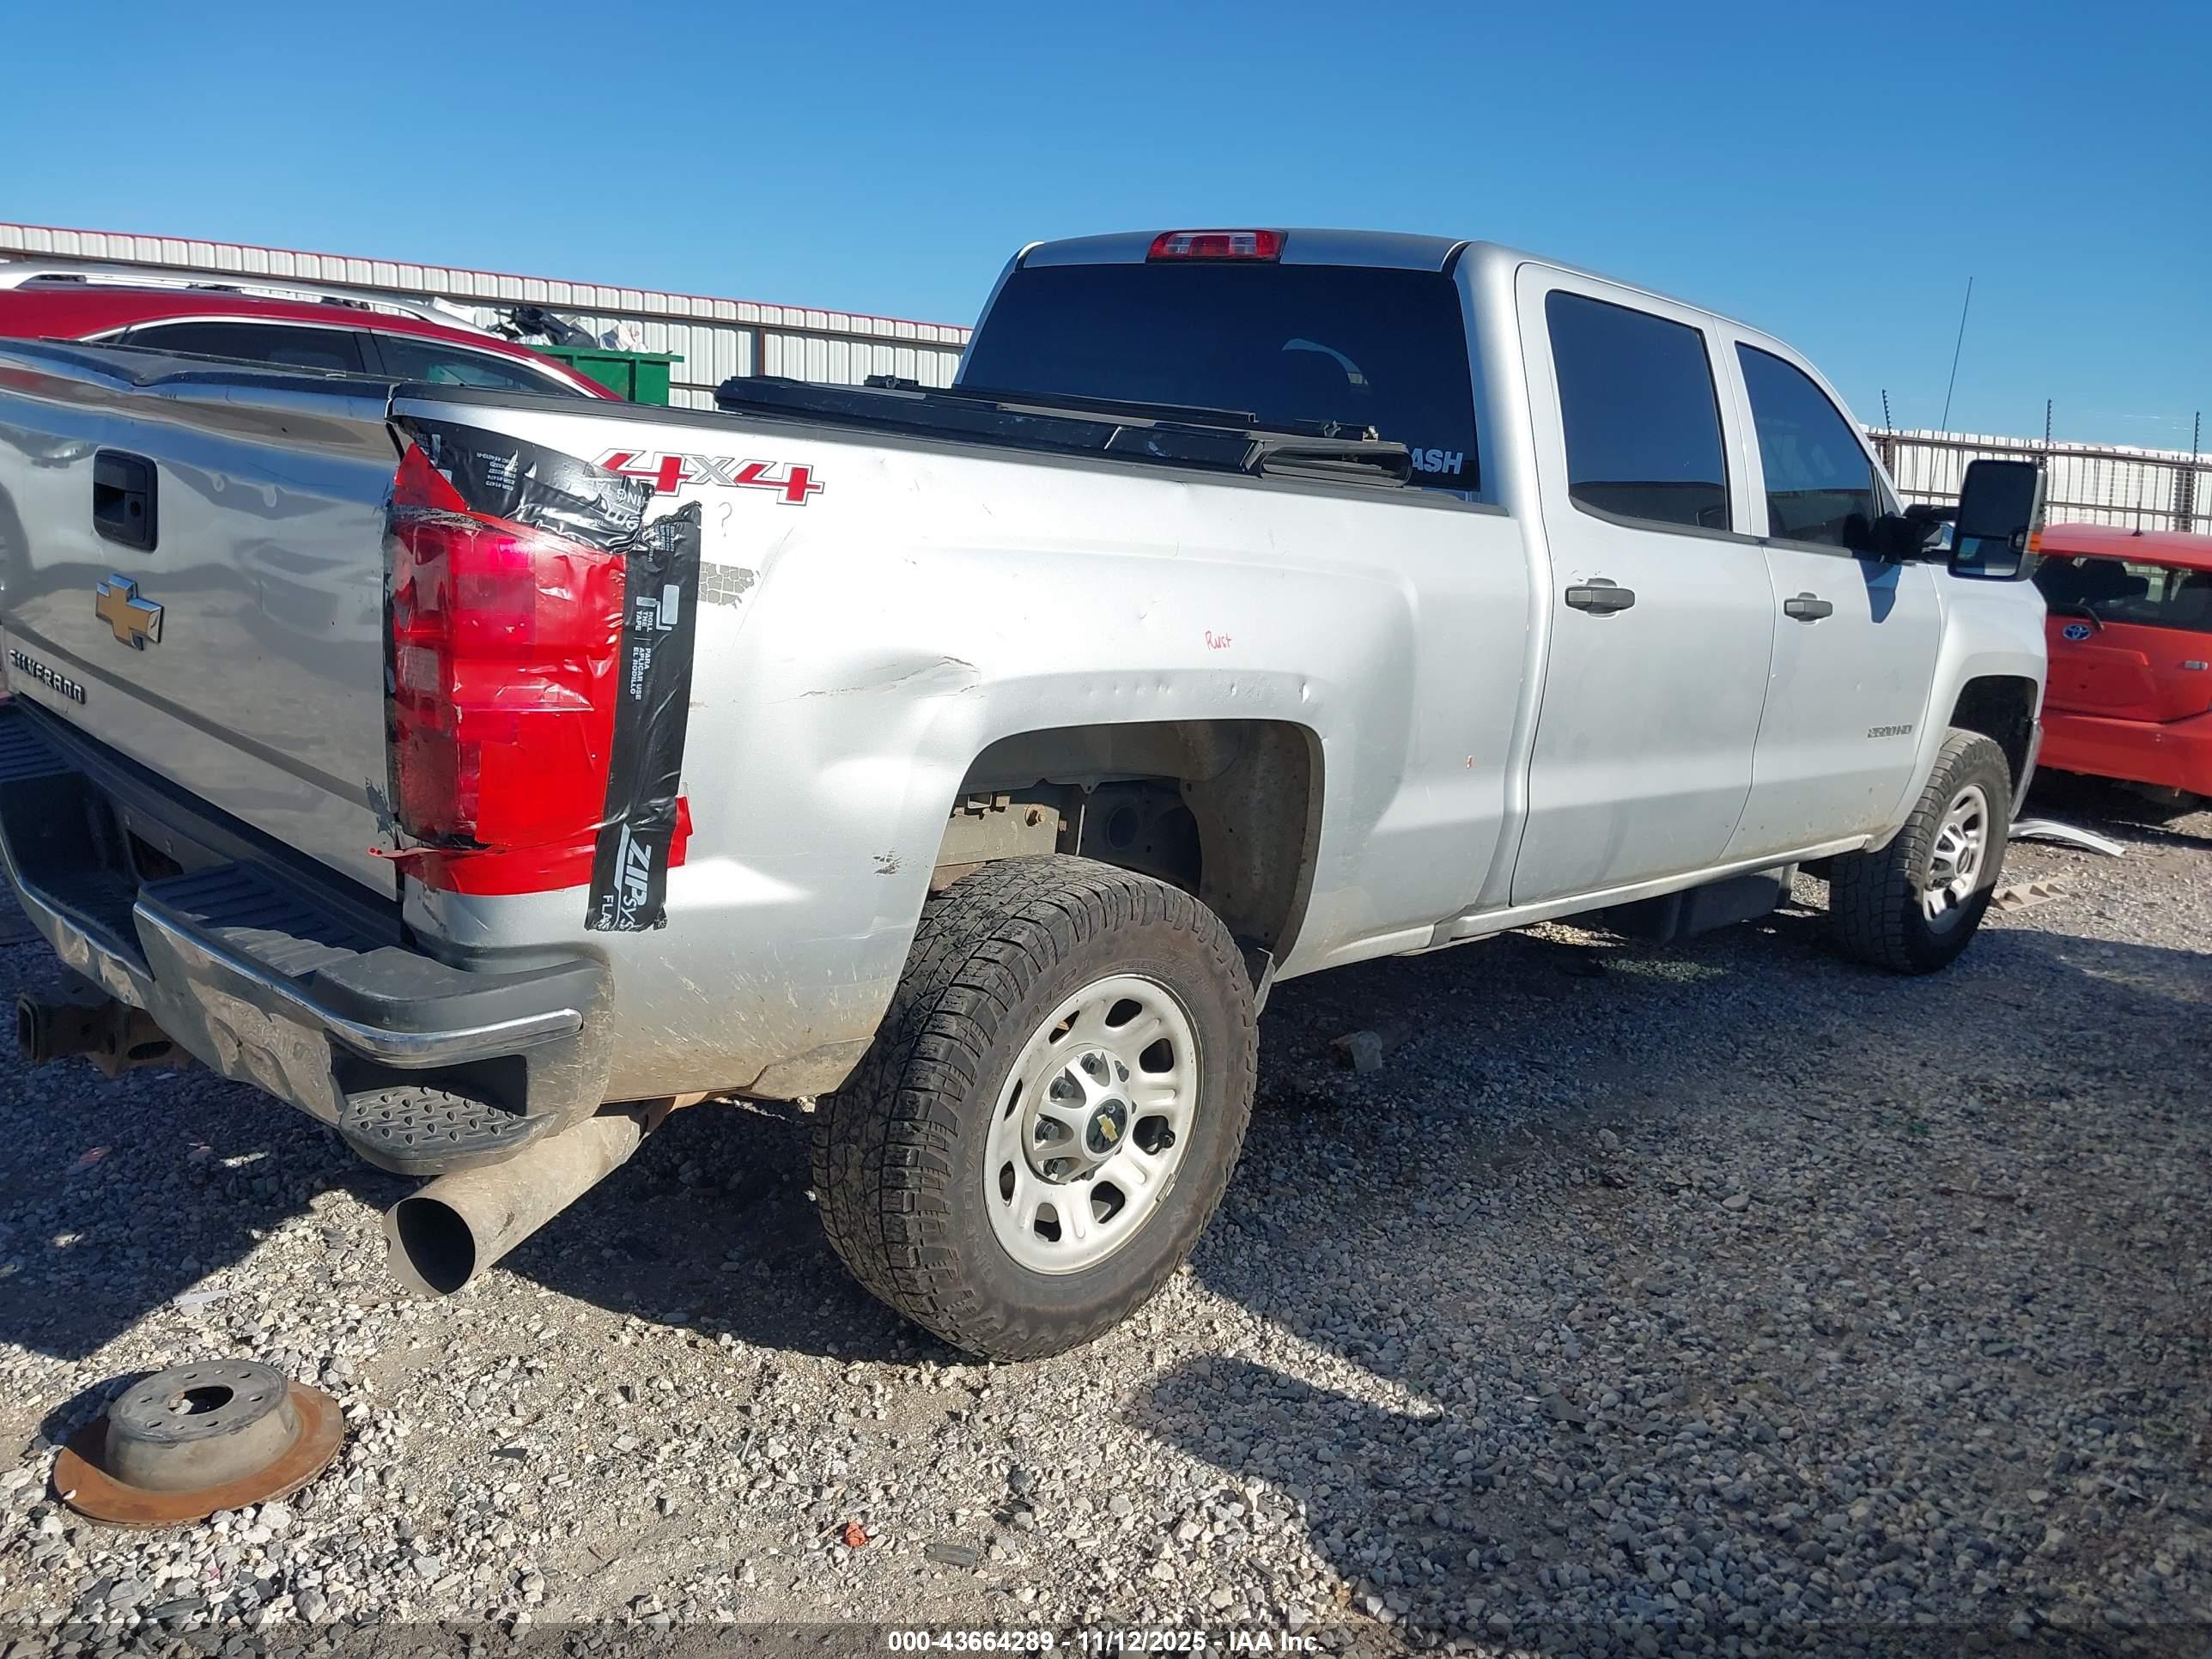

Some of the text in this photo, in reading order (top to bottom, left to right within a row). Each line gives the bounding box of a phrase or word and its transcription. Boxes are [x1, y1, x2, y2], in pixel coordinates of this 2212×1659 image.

[636, 647, 645, 683] APLICAR
[1205, 630, 1231, 651] Rust
[9, 648, 85, 705] SILVERADO
[629, 647, 639, 696] EL RODILLO
[624, 837, 652, 906] ZIP
